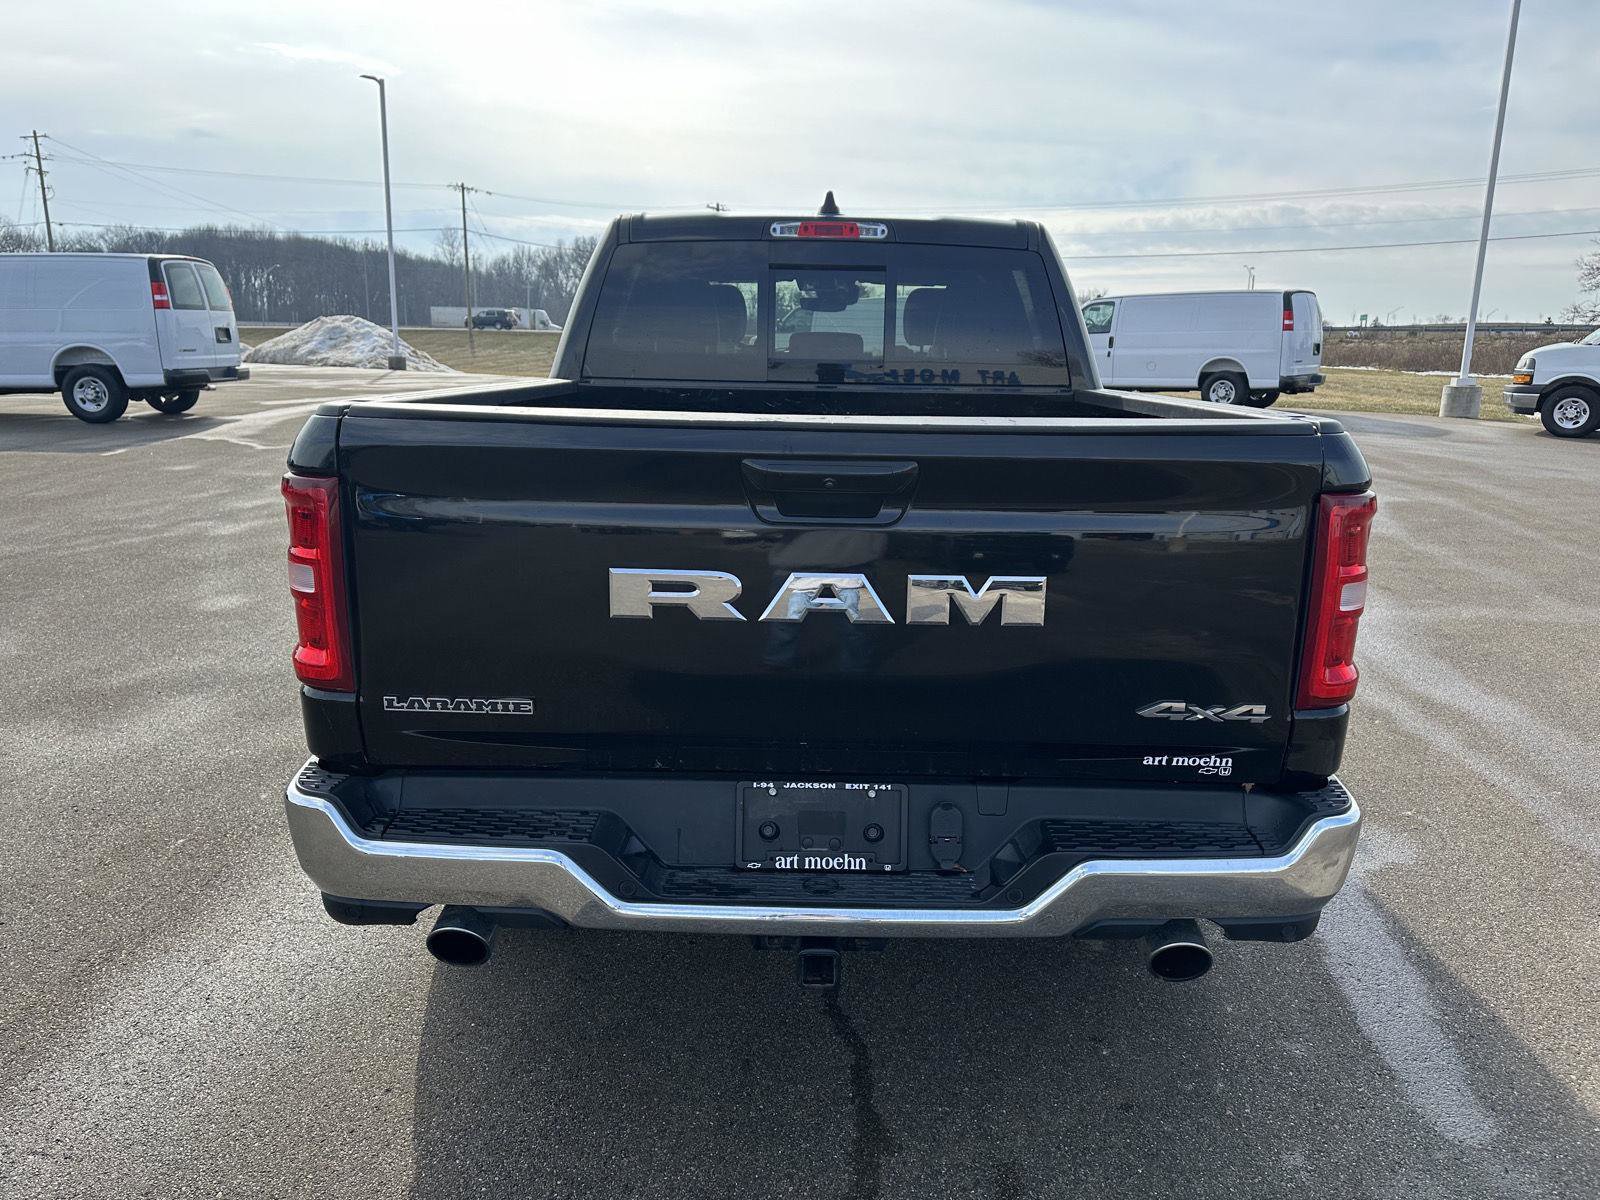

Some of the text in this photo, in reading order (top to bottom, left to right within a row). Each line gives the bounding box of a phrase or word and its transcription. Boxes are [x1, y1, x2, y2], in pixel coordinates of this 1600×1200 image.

[608, 567, 1048, 626] RAM
[383, 696, 534, 715] LARAMIE
[1142, 755, 1233, 767] art moehn
[774, 853, 867, 871] art moehn
